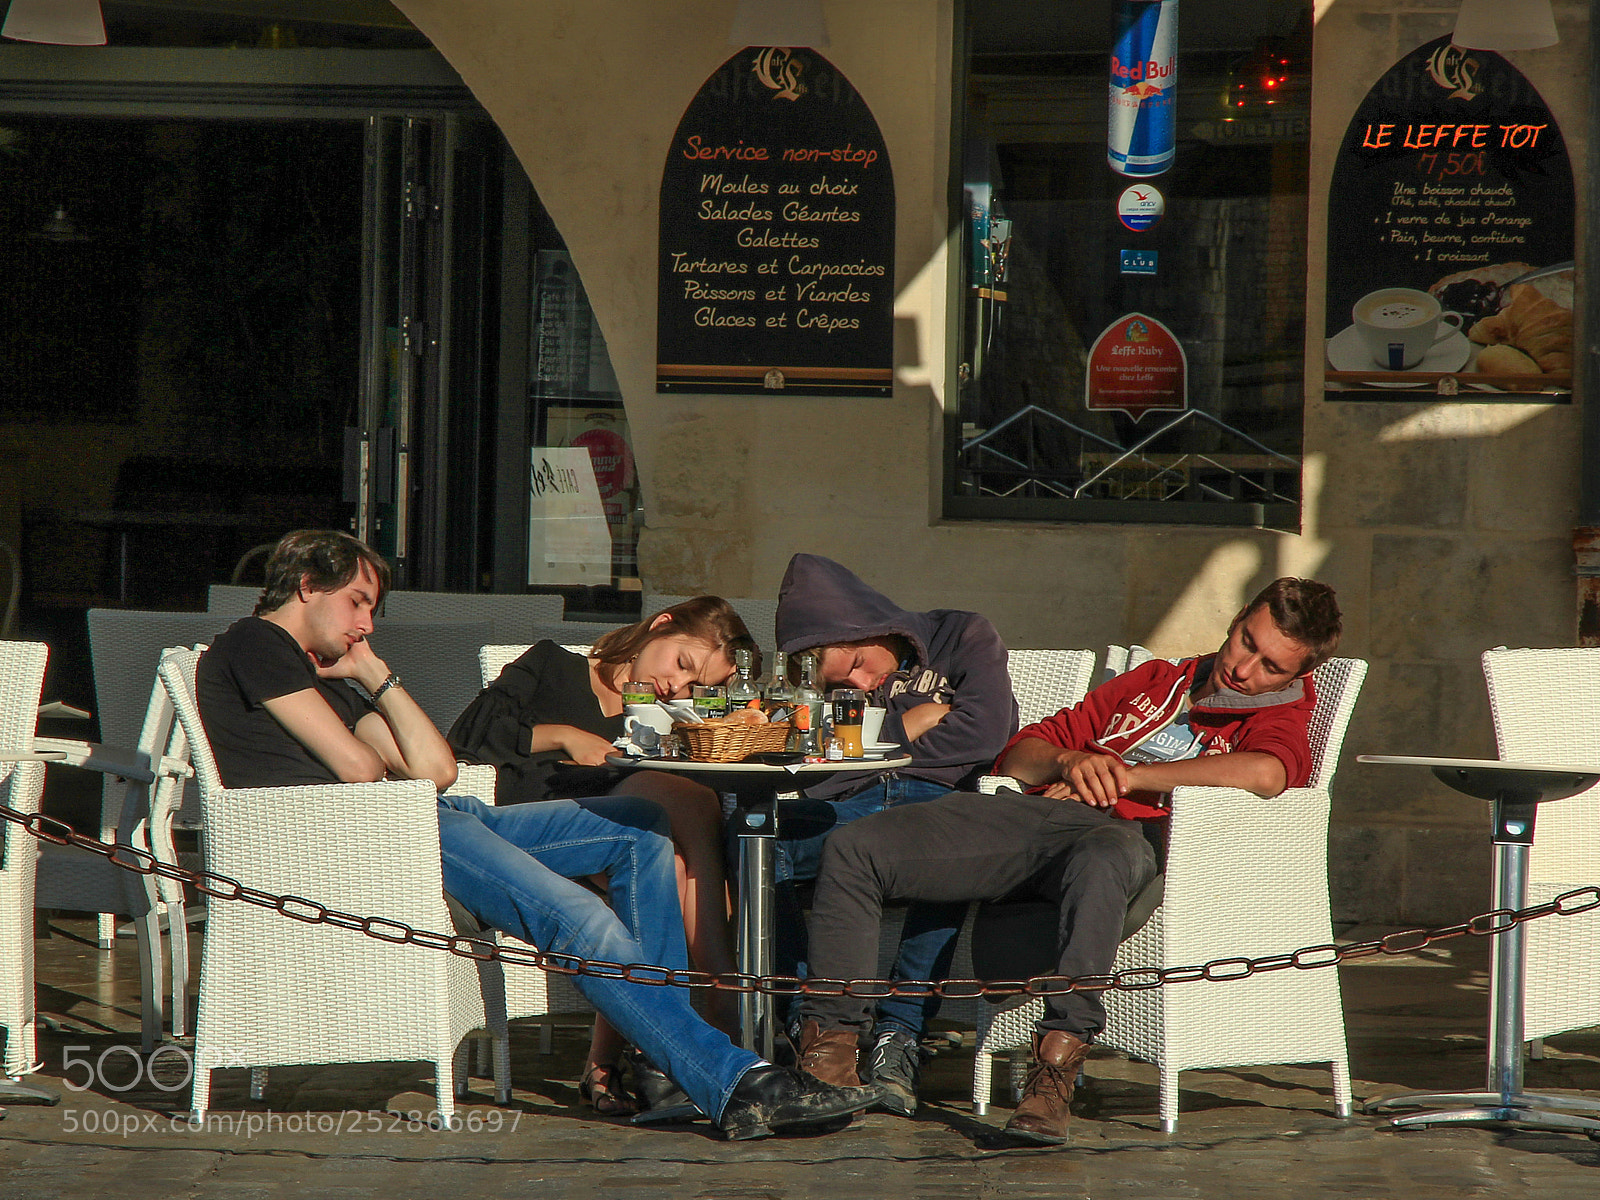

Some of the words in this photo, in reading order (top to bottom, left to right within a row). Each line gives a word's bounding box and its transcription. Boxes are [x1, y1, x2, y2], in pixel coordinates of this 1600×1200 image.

[1111, 56, 1142, 80] Red
[1146, 55, 1176, 79] Bull
[1362, 124, 1396, 149] LE
[1403, 124, 1491, 150] LEFFE
[1499, 123, 1548, 148] TOT
[682, 135, 770, 161] Service
[782, 143, 878, 169] non-stop
[700, 174, 769, 195] Moules
[778, 183, 800, 195] au
[809, 175, 859, 195] choix
[1393, 181, 1417, 196] Une
[1422, 182, 1465, 196] boisson
[1470, 183, 1514, 196] chaude
[698, 200, 773, 221] Salades
[783, 201, 861, 223] Géantes
[1444, 197, 1481, 207] chocolat
[1384, 212, 1392, 225] 1
[1396, 215, 1429, 225] verre
[1434, 212, 1451, 225] de
[1456, 213, 1476, 228] jus
[1481, 212, 1533, 228] d'orange
[737, 228, 820, 249] Galettes
[1390, 230, 1418, 246] Pain,
[1422, 231, 1466, 246] beurre,
[1470, 231, 1525, 244] confiture
[671, 252, 748, 274] Tartares
[757, 259, 779, 275] et
[788, 255, 885, 280] Carpaccios
[1123, 259, 1154, 267] CLUB
[1437, 251, 1490, 262] croissant
[684, 280, 756, 301] Poissons
[765, 285, 786, 301] et
[796, 281, 871, 302] Viandes
[694, 306, 757, 327] Glaces
[765, 312, 787, 328] et
[796, 308, 860, 333] Crêpes
[1111, 345, 1136, 357] Leffe
[1138, 346, 1164, 358] Ruby
[1113, 364, 1144, 372] nouvelle
